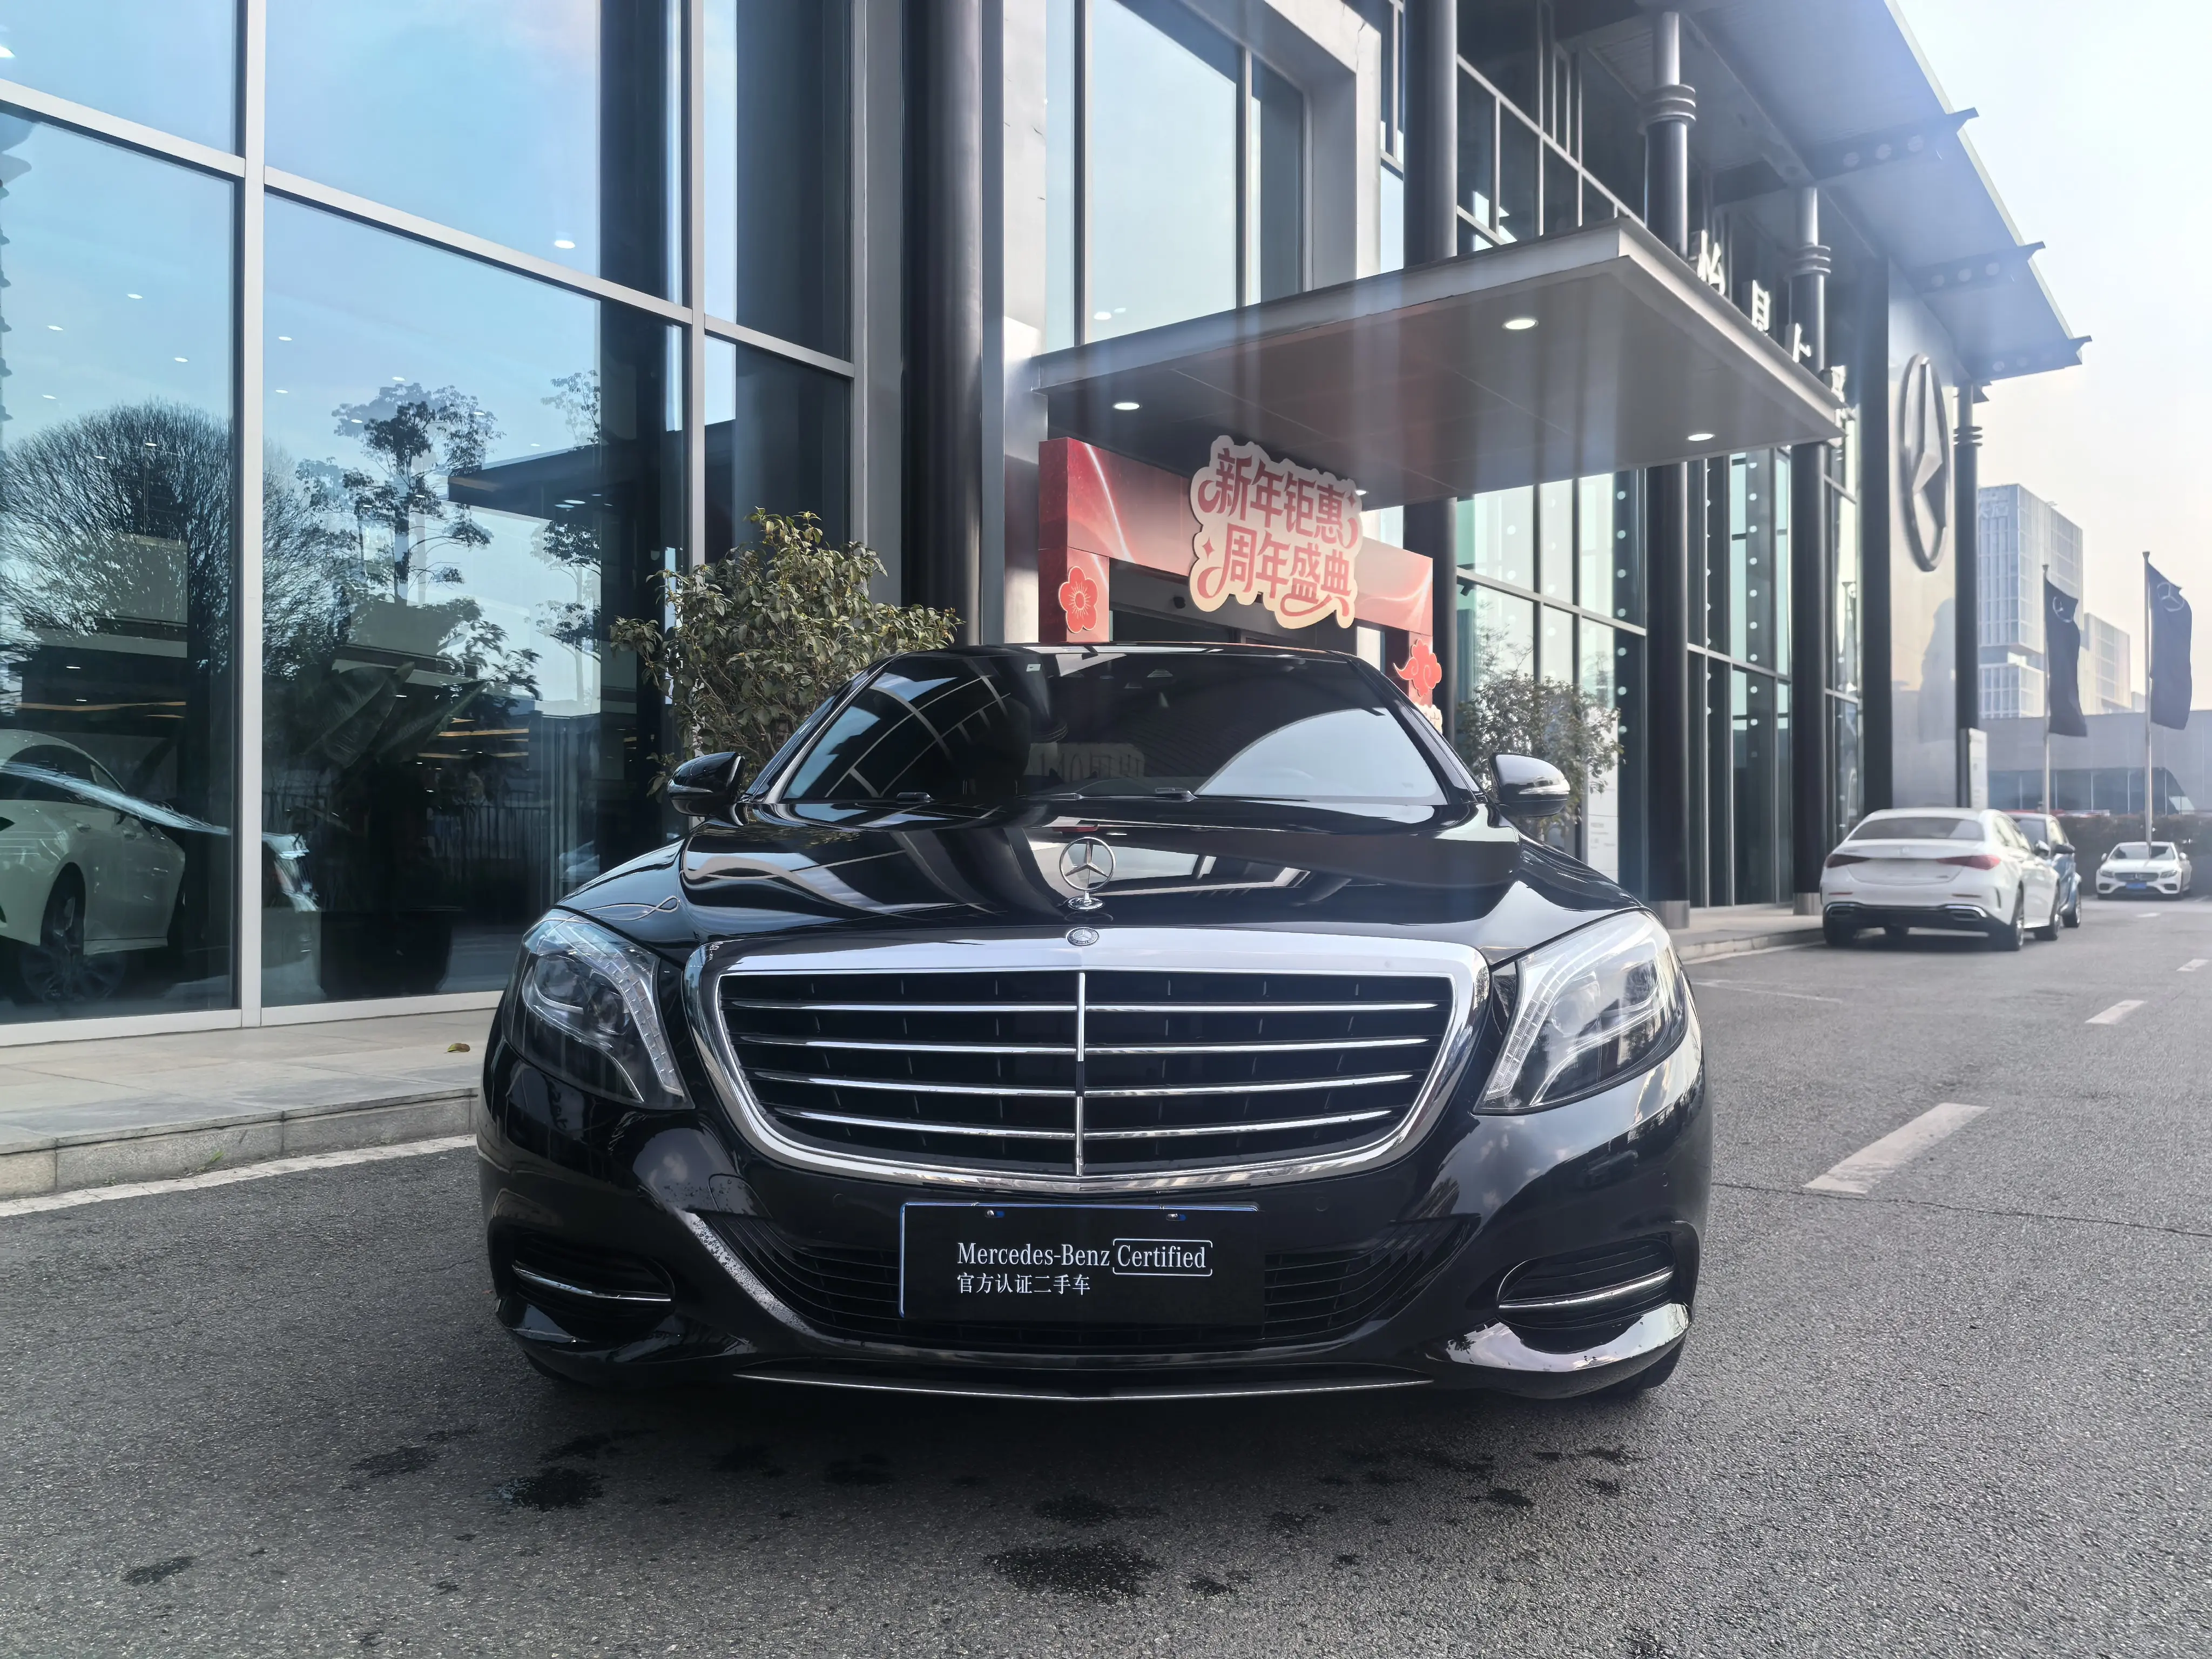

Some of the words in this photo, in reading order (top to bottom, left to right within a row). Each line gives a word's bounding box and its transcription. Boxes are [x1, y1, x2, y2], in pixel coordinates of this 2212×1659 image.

[1198, 448, 1358, 549] 新年钜惠
[1197, 523, 1352, 617] 周年盛典
[957, 1242, 1110, 1266] Mercedes-Benz
[1117, 1244, 1206, 1269] Certified
[957, 1272, 1091, 1296] 官方认证二手车
